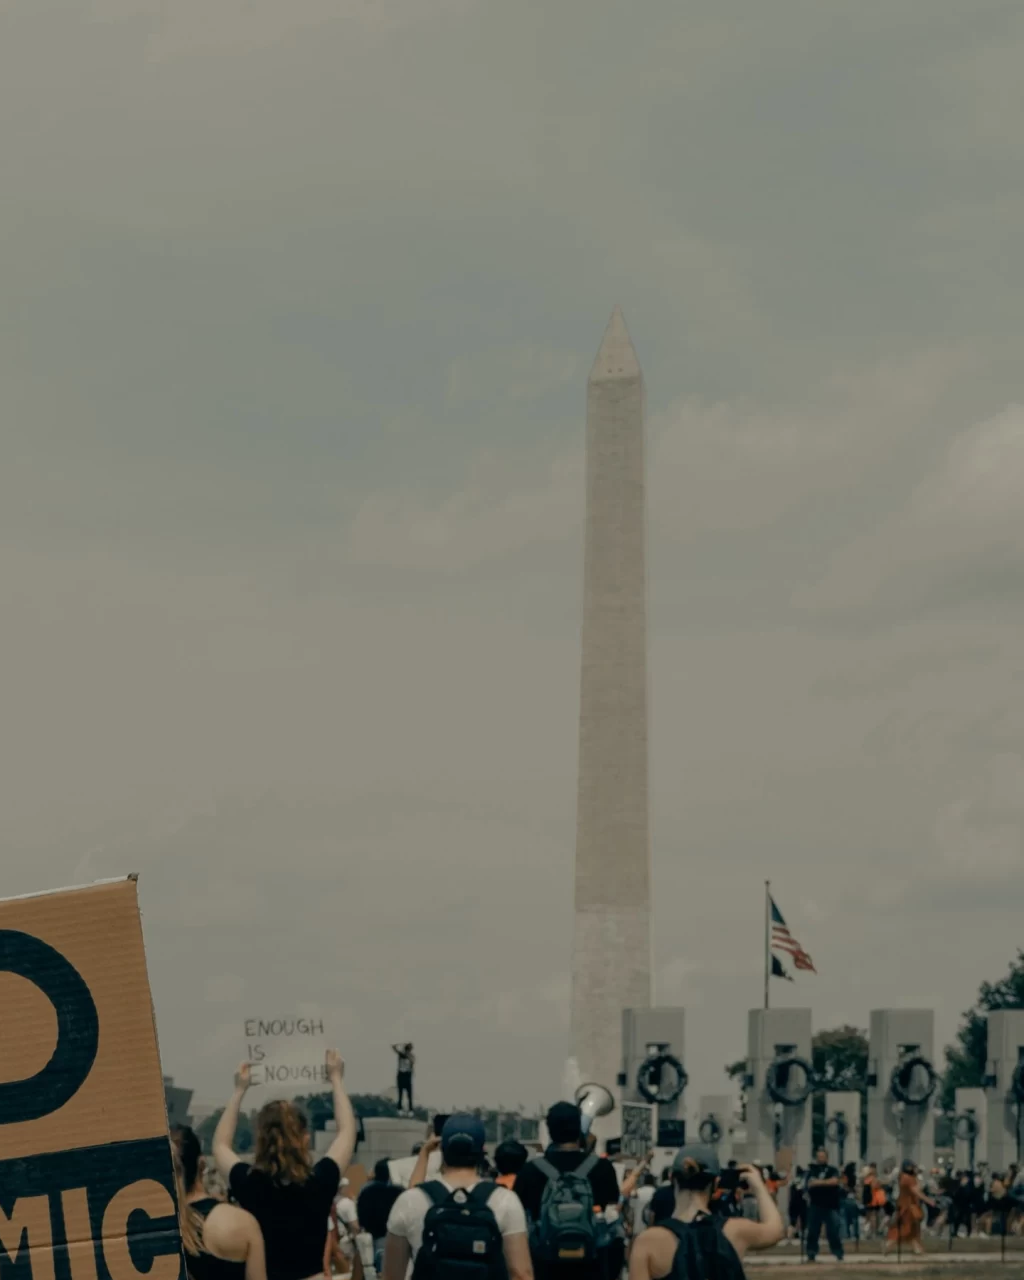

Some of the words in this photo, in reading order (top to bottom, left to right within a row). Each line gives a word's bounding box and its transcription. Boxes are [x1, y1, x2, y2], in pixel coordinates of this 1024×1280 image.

[243, 1018, 324, 1037] ENOUGH
[247, 1043, 266, 1061] IS
[247, 1062, 327, 1086] ENOUGH
